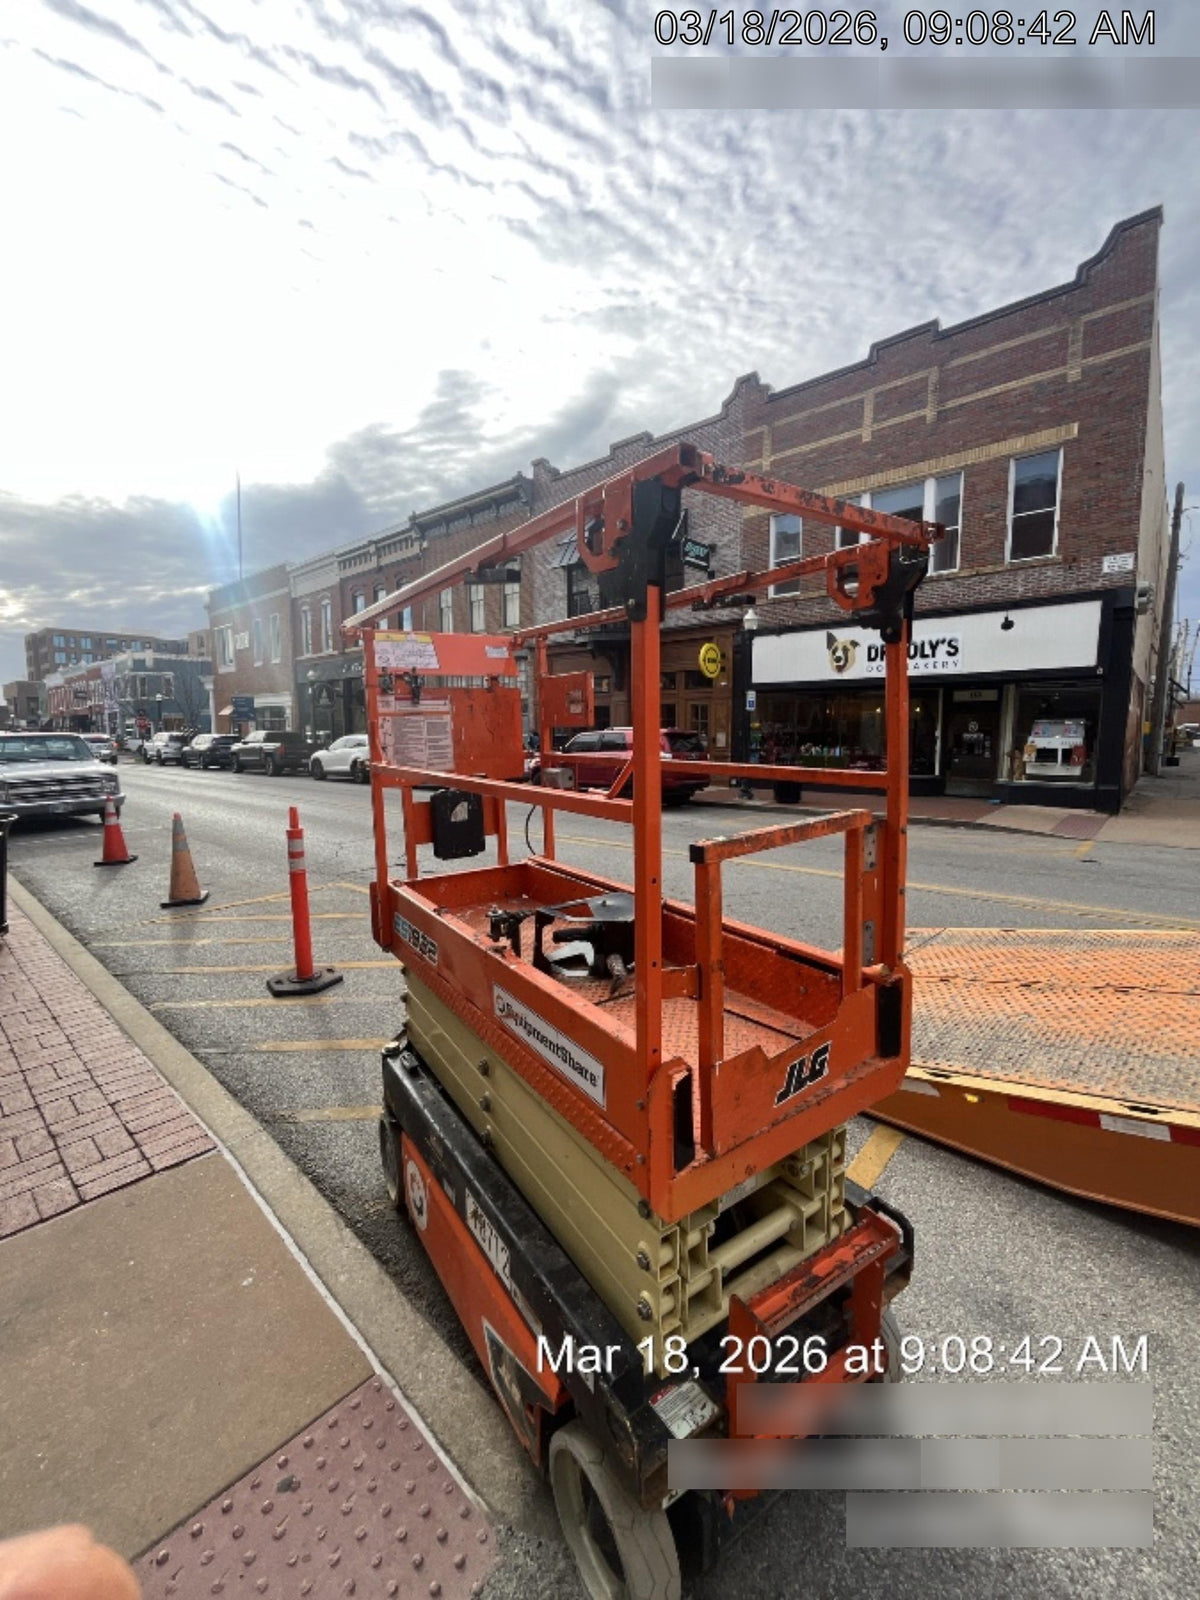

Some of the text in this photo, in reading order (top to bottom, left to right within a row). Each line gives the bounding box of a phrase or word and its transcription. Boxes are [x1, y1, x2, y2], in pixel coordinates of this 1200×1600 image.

[867, 638, 959, 662] DOLY'S
[906, 660, 959, 670] AKERY
[774, 1040, 831, 1107] JLG
